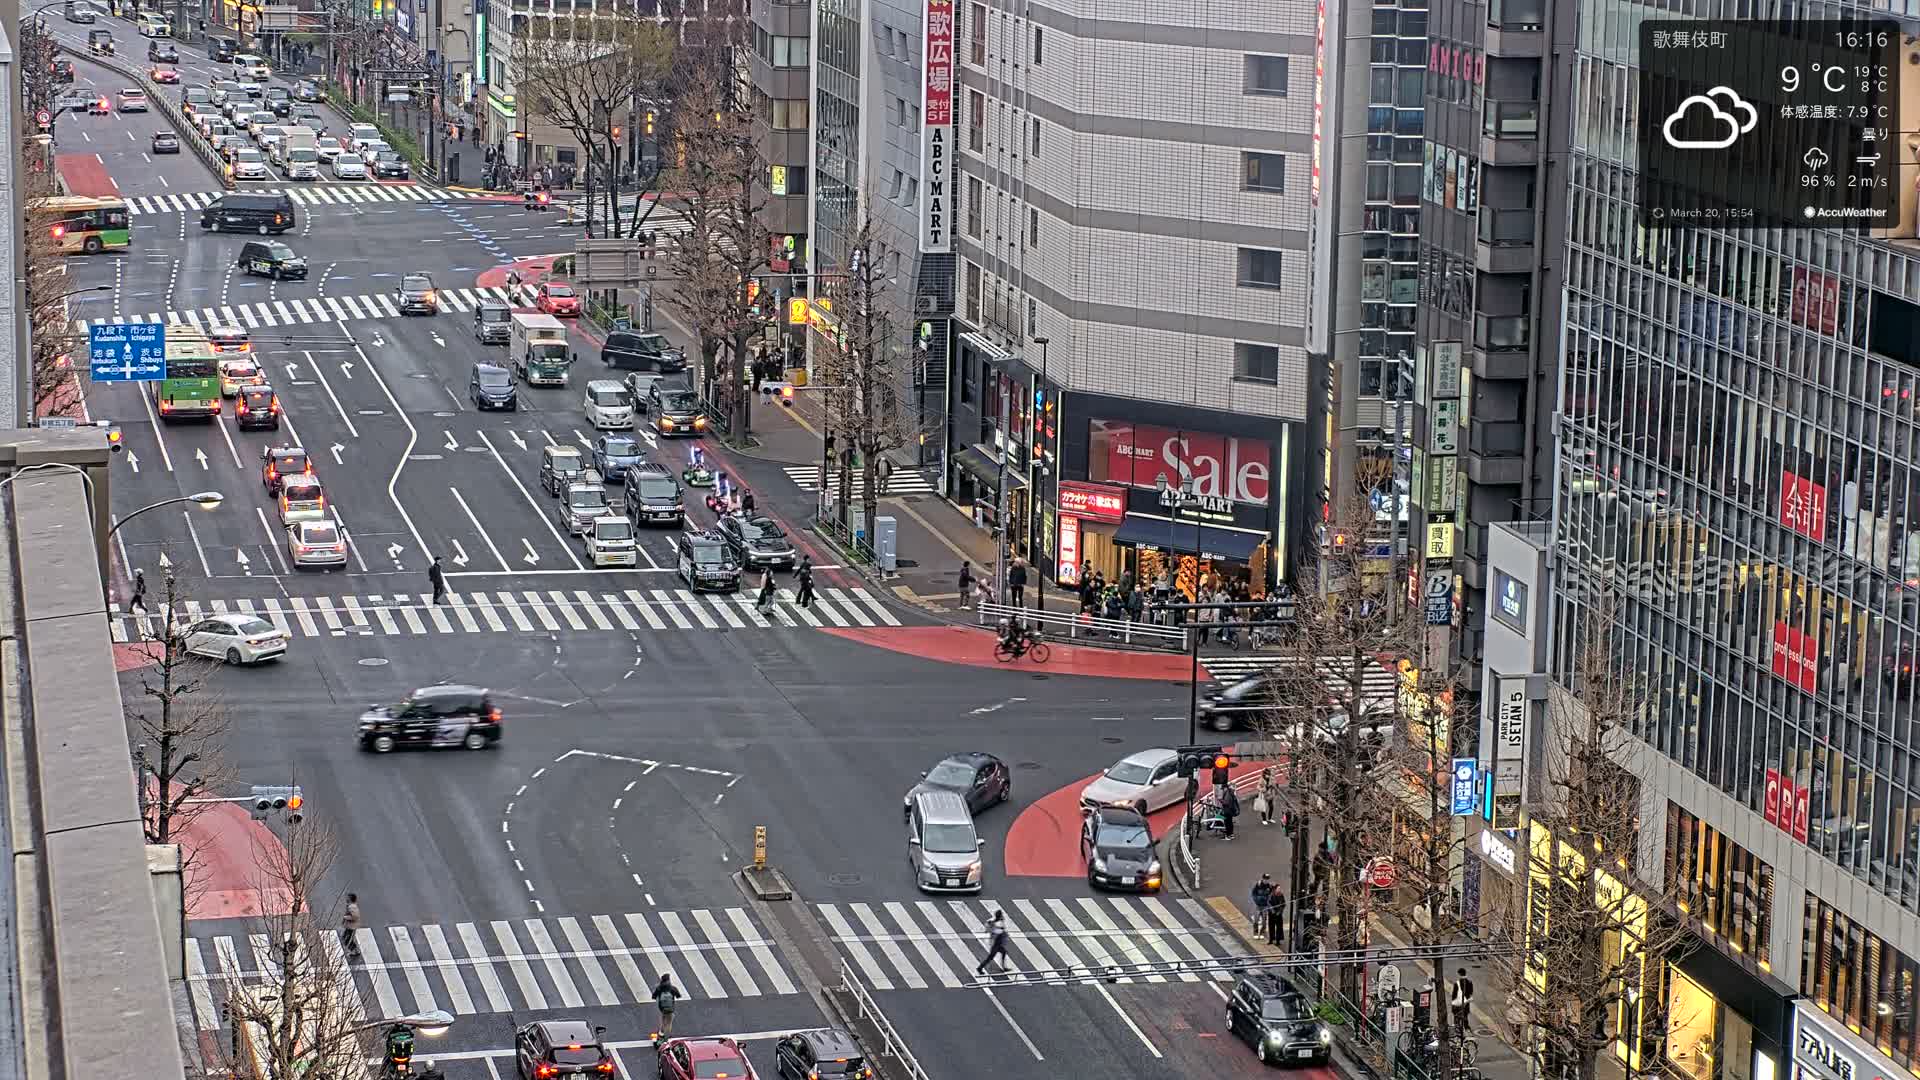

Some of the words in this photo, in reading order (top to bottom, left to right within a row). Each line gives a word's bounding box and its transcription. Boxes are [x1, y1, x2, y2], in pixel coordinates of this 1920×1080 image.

[928, 11, 951, 92] 歌広場
[1429, 43, 1484, 85] AMIGO
[927, 99, 949, 110] 受付
[927, 111, 949, 121] 5F
[930, 128, 943, 244] ABC-MART
[96, 326, 125, 335] 九段下
[1162, 437, 1270, 503] Sale
[1786, 482, 1822, 531] 会計
[1435, 514, 1447, 523] 7F
[1431, 526, 1444, 554] 買取
[1510, 692, 1523, 702] 5
[1501, 702, 1509, 720] CITY
[1501, 722, 1509, 740] PARK
[1509, 705, 1523, 747] ISETAN
